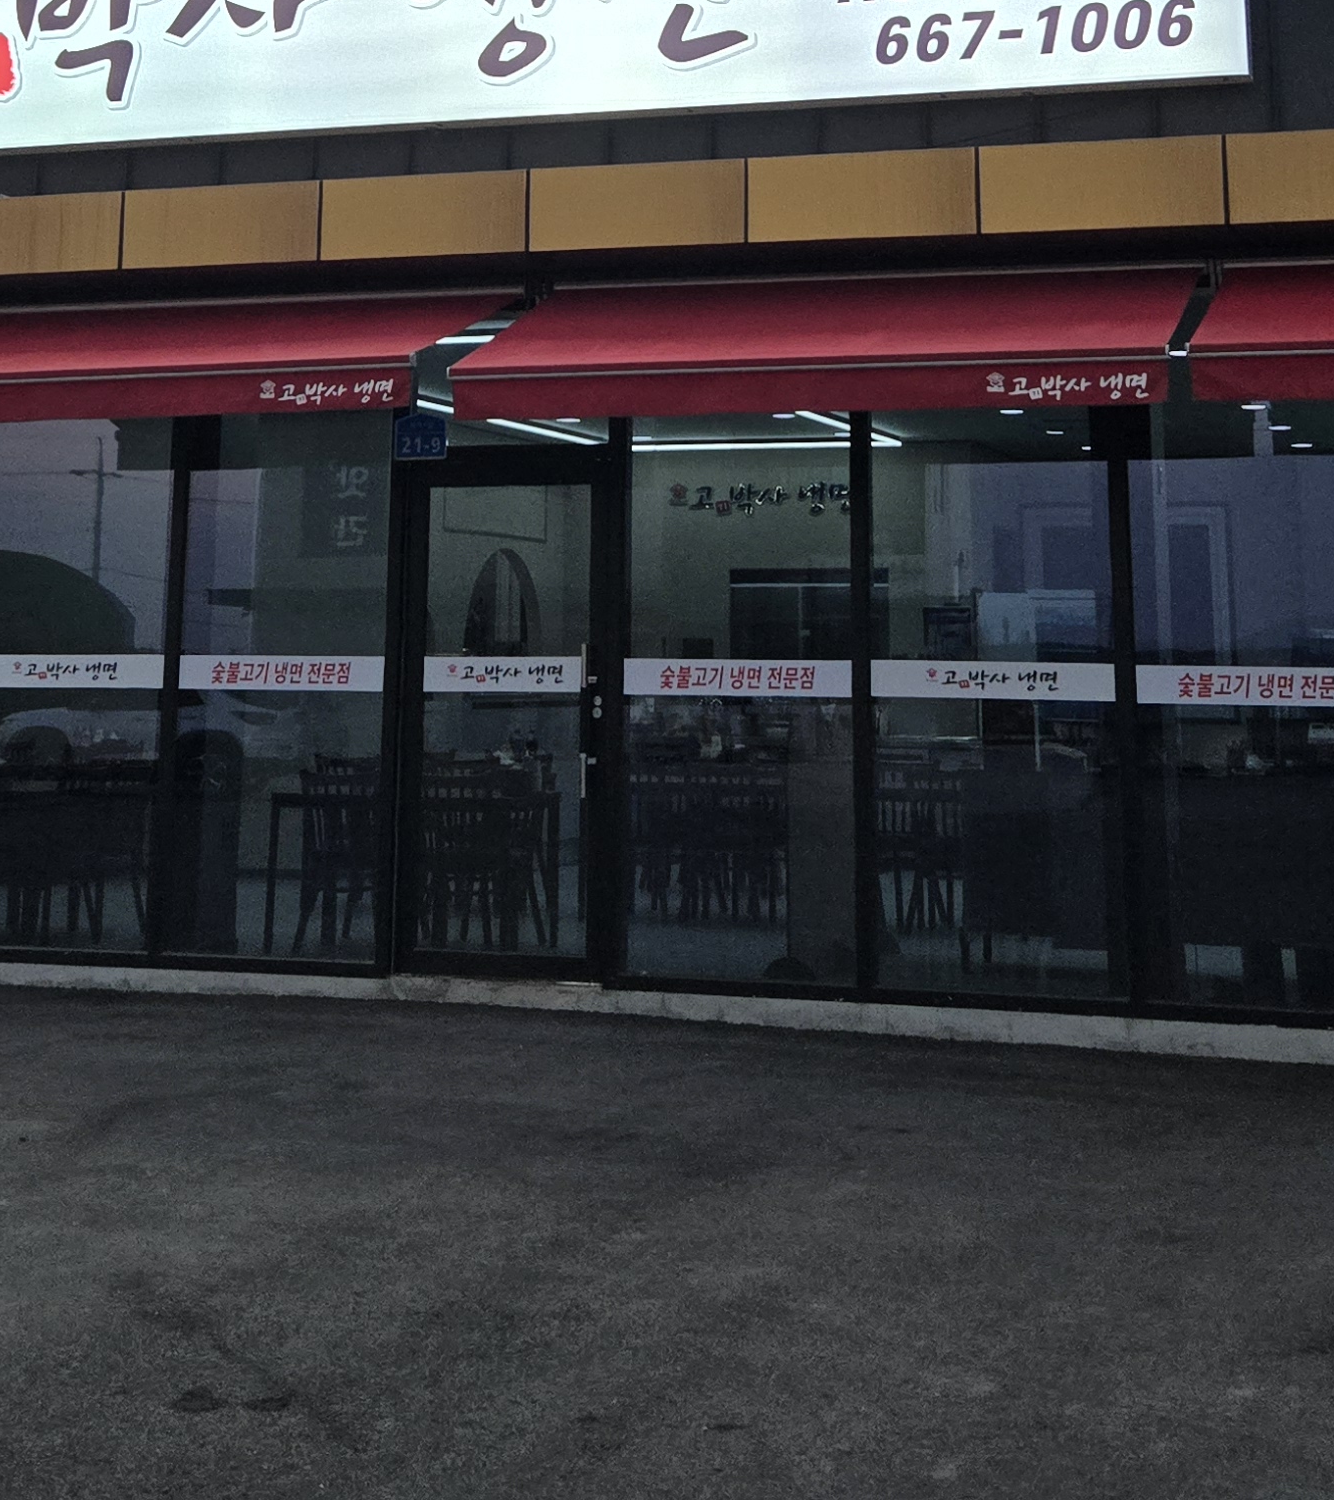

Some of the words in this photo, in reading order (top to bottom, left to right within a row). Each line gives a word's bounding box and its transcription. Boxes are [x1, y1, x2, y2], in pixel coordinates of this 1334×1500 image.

[354, 378, 396, 404] 냉면
[1099, 372, 1150, 400] 냉면
[401, 436, 441, 454] 21-9
[85, 661, 118, 681] 냉면
[211, 661, 268, 684] 숯불고기
[274, 662, 302, 685] 냉면
[307, 661, 352, 685] 전문점
[527, 663, 564, 684] 냉면
[659, 664, 724, 689] 숯불고기
[729, 665, 763, 690] 냉면
[766, 665, 815, 690] 전문점
[1017, 669, 1059, 692] 냉면
[1178, 672, 1251, 698] 숯불고기
[1257, 673, 1294, 699] 냉면
